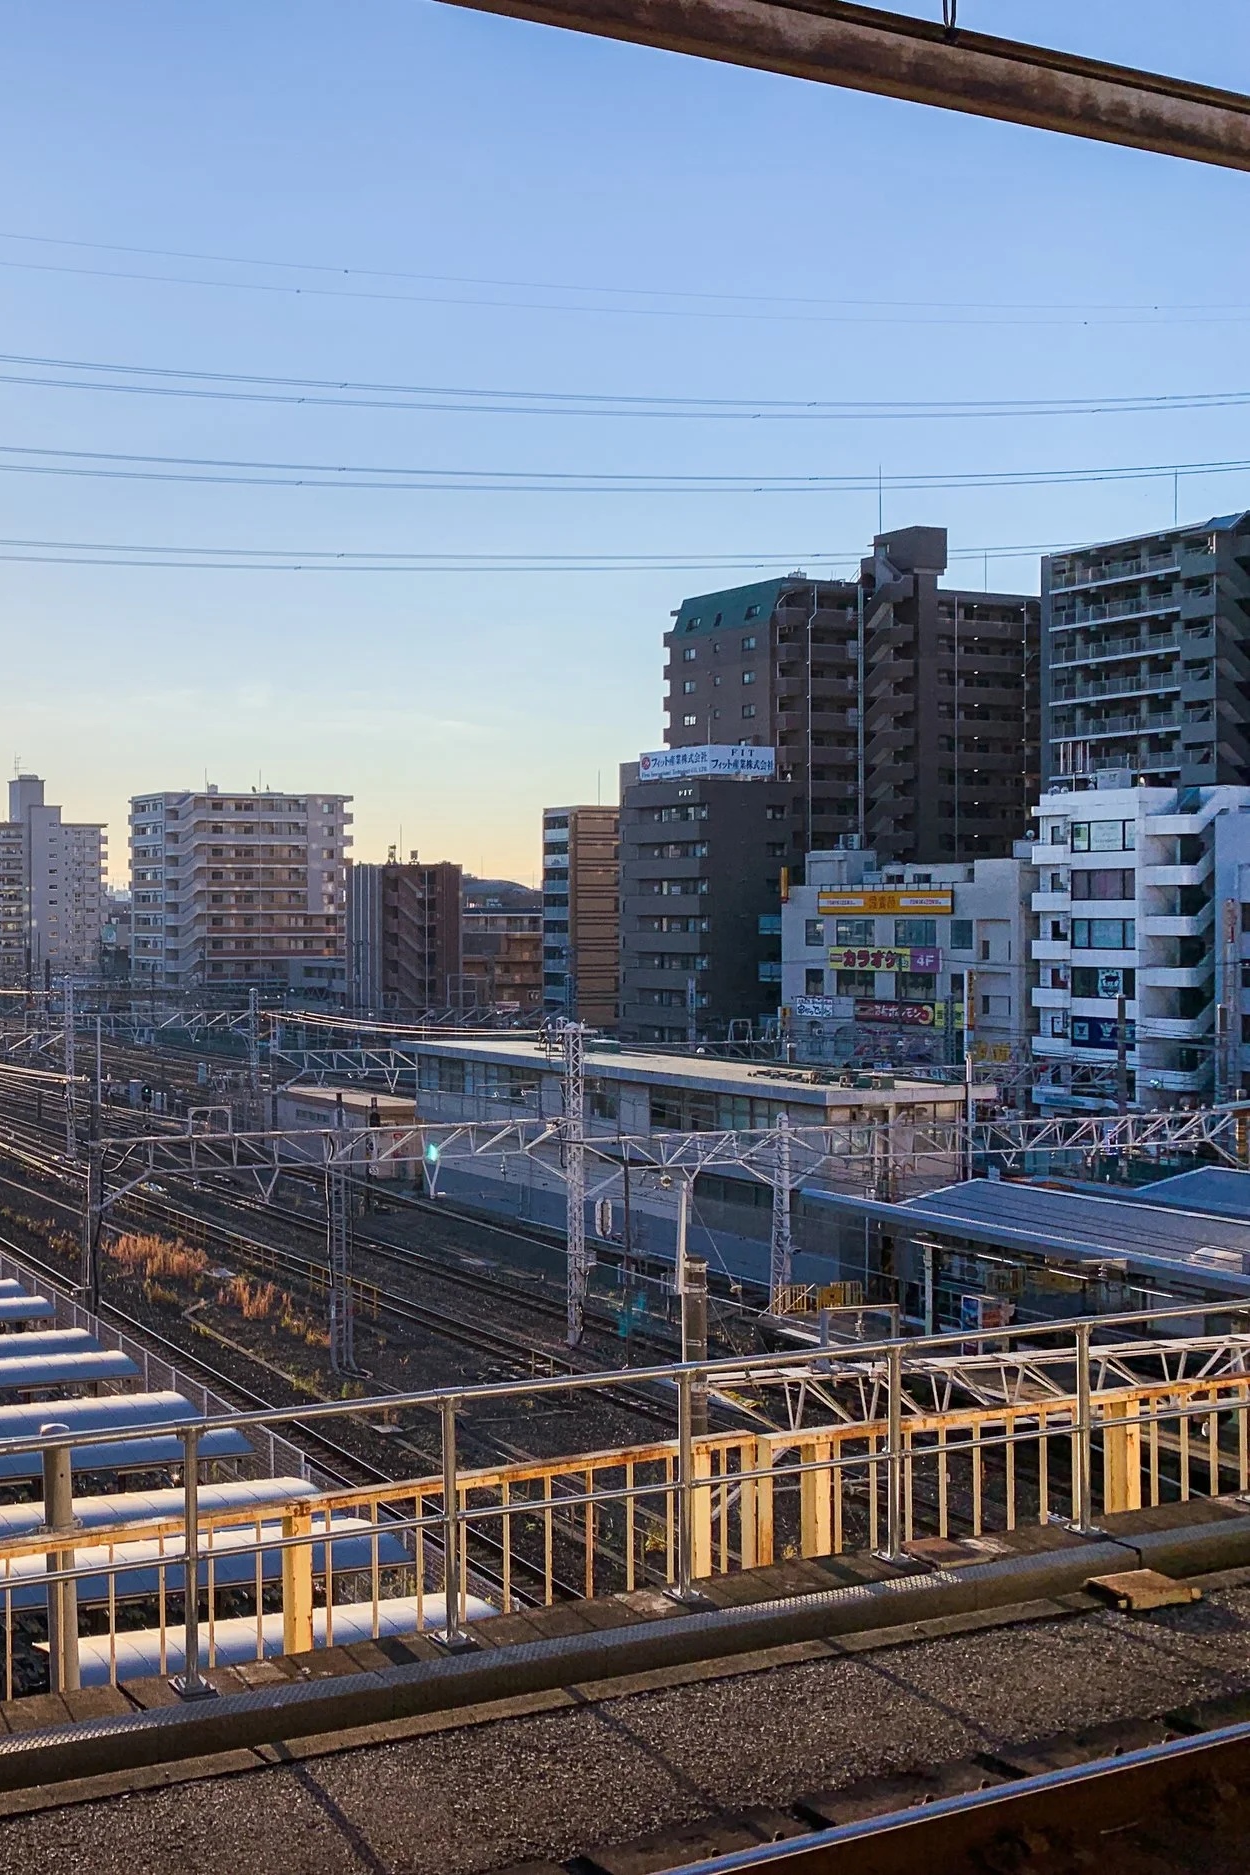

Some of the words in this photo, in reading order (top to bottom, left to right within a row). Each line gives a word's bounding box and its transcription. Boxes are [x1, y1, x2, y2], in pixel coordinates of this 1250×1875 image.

[731, 749, 755, 757] FIT
[678, 789, 693, 797] FIT
[843, 949, 898, 969] カラオケ
[916, 954, 935, 967] 4F
